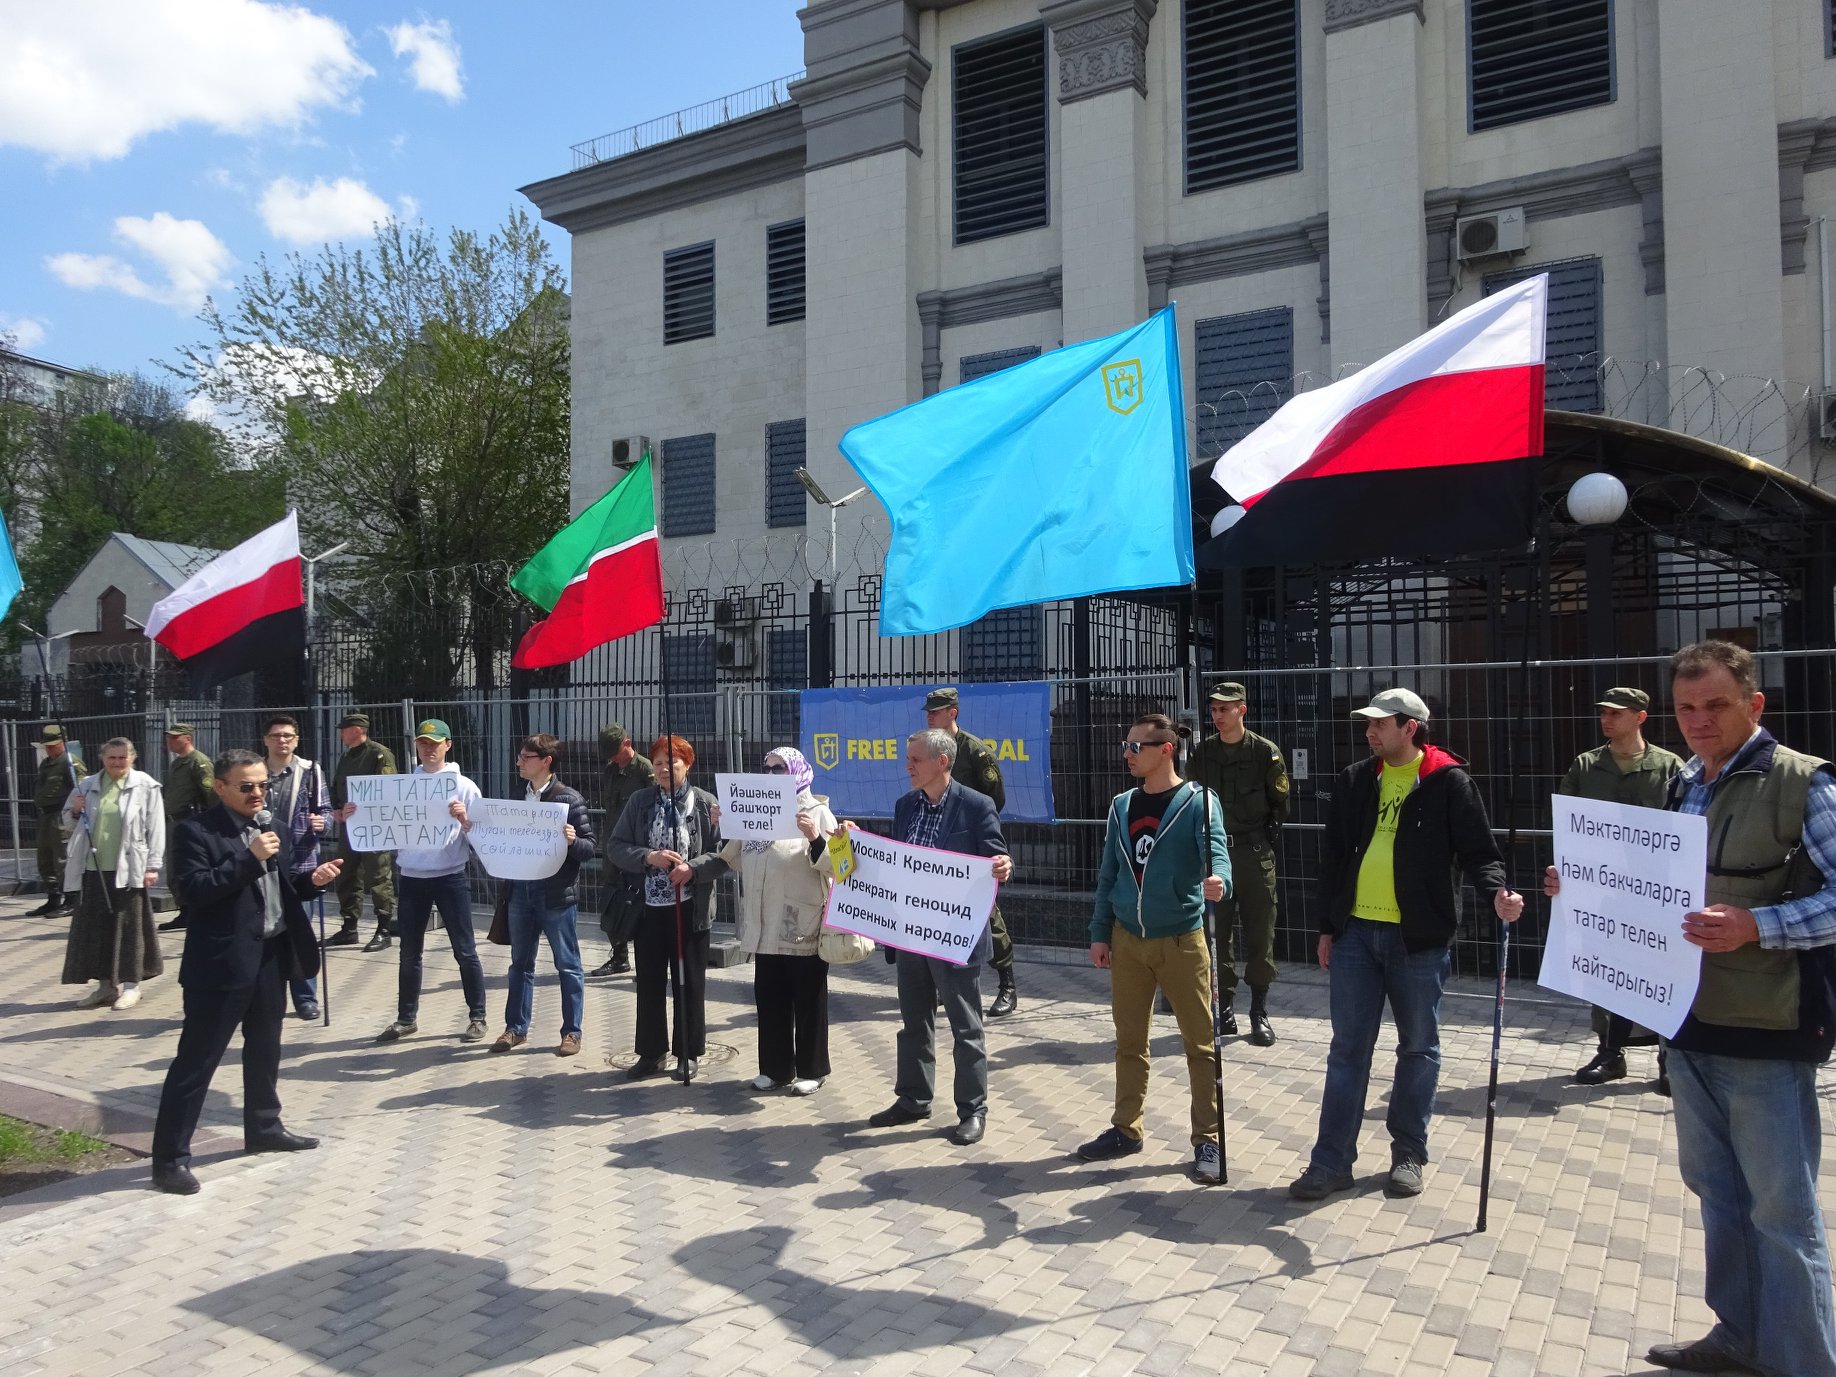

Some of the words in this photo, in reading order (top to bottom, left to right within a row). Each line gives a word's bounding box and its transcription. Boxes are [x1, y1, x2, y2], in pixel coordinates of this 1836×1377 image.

[847, 739, 898, 760] FREE
[350, 780, 383, 802] МИН
[393, 778, 457, 801] ТАТАР
[729, 784, 782, 800] Йәшәһен
[730, 800, 782, 817] башҡорт
[364, 805, 427, 822] ТЕЛЕН
[742, 818, 774, 831] теле!
[1570, 812, 1681, 853] Мәктәпләргә
[850, 838, 897, 866] Москва!
[903, 853, 971, 880] Кремль!
[843, 874, 898, 903] Прекрати
[905, 894, 972, 921] геноцид
[1561, 856, 1594, 883] һәм
[1598, 864, 1691, 908] бакчаларга
[837, 902, 898, 931] коренных
[904, 923, 975, 949] народов!
[1572, 909, 1616, 939] татар
[1620, 922, 1668, 952] телен
[1571, 954, 1673, 1006] кайтарыгыз!
